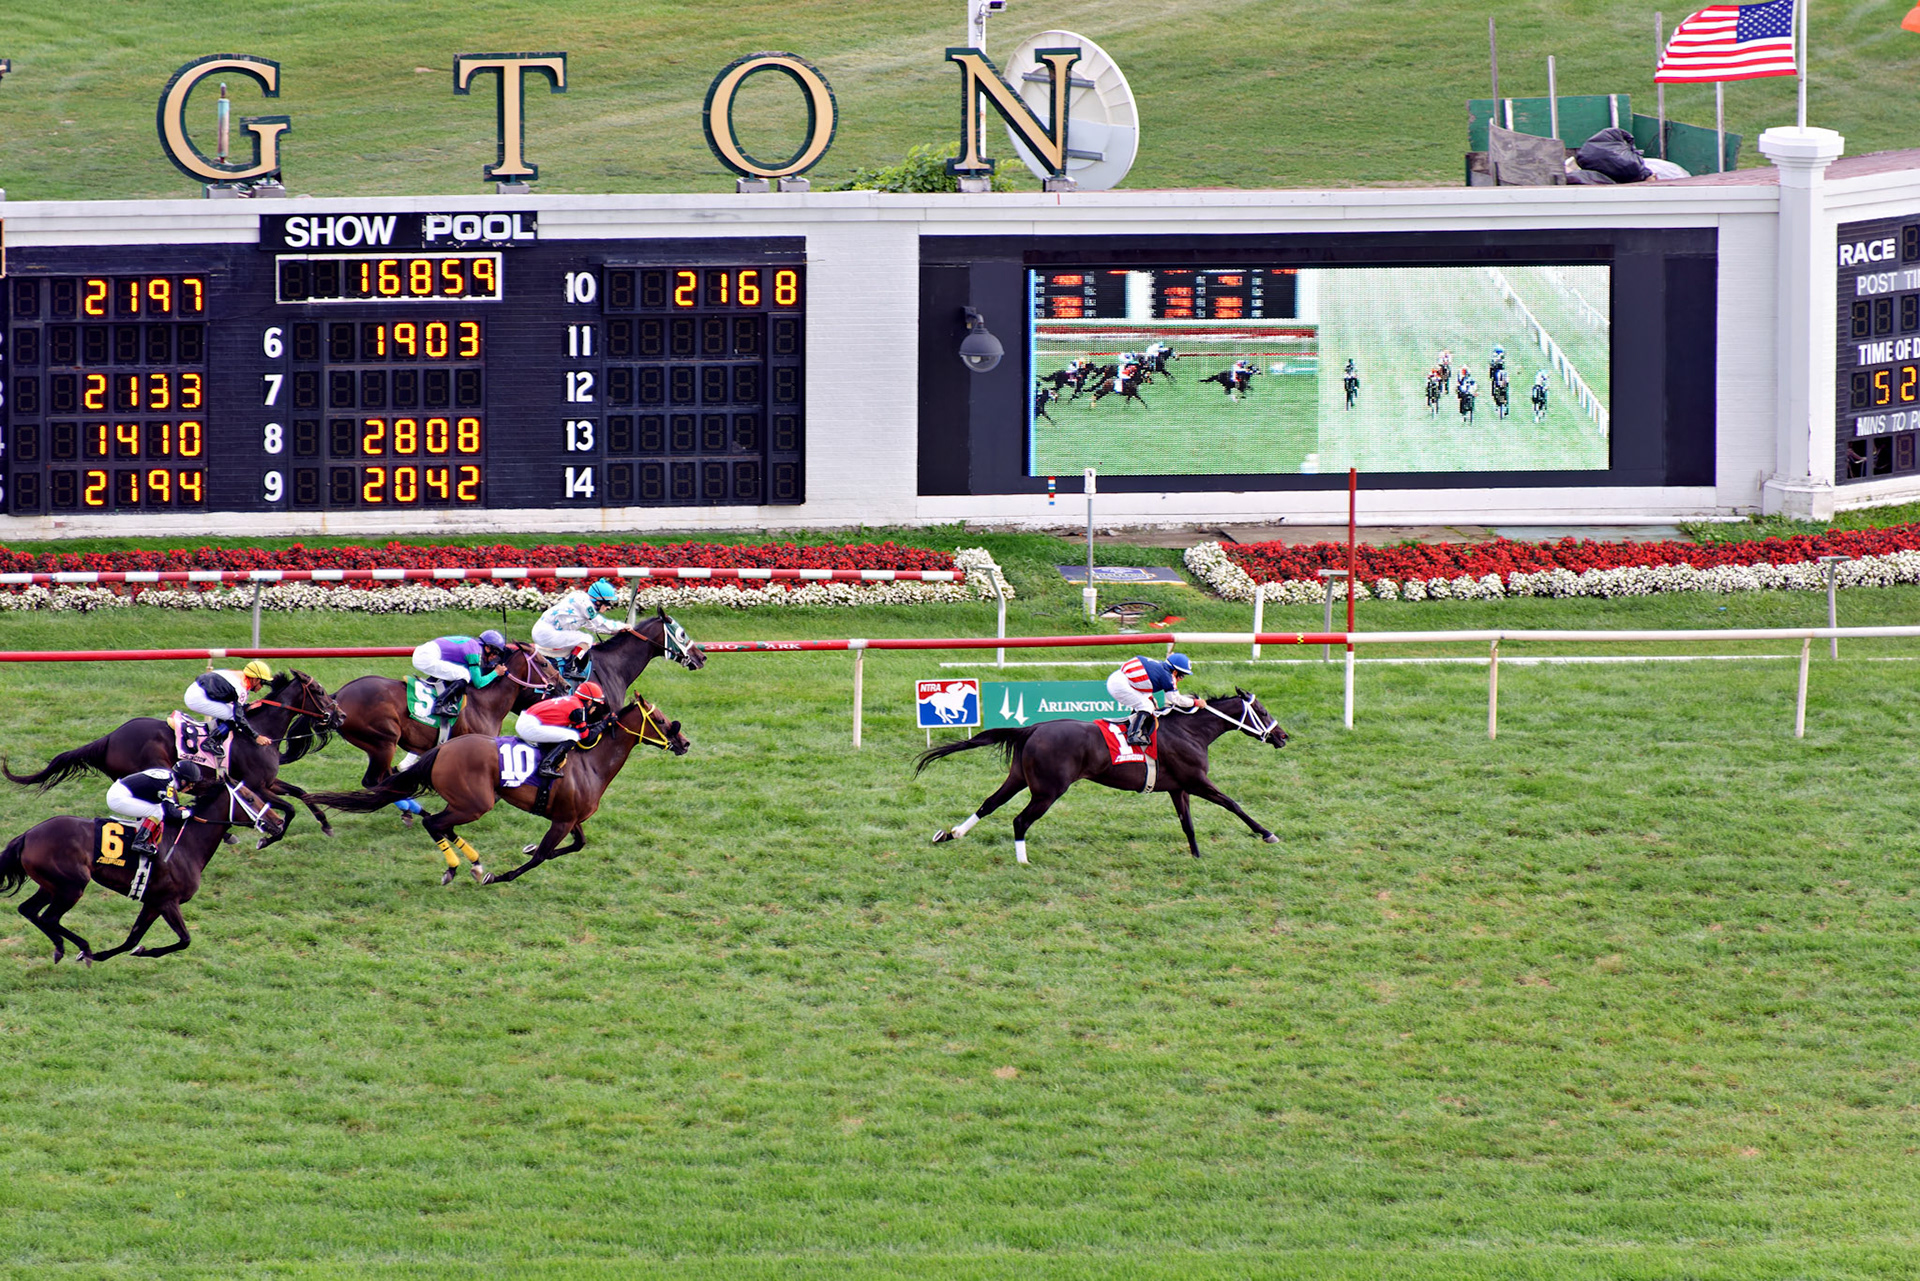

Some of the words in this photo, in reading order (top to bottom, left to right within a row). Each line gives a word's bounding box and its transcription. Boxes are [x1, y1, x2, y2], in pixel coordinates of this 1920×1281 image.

[284, 215, 397, 248] SHOW
[425, 214, 535, 241] POOL
[1839, 238, 1896, 267] RACE
[361, 258, 495, 295] 16859
[565, 271, 597, 303] 10
[674, 270, 798, 307] 2168
[1857, 272, 1898, 296] POST
[84, 278, 203, 315] 2197
[263, 326, 283, 359] 6
[376, 321, 480, 358] 1903
[568, 325, 592, 357] 11
[1858, 341, 1894, 366] TIME
[1895, 339, 1912, 361] OF
[84, 373, 202, 410] 2133
[264, 374, 283, 406] 7
[566, 371, 594, 403] 12
[98, 421, 202, 458] 1410
[264, 423, 283, 455] 8
[363, 417, 480, 455] 2808
[566, 420, 595, 452] 13
[1856, 415, 1887, 437] MINS
[1891, 411, 1907, 432] TO
[84, 469, 202, 506] 2194
[264, 470, 283, 502] 9
[363, 465, 480, 503] 2042
[565, 467, 595, 498] 14
[414, 681, 435, 717] 5
[920, 683, 942, 692] NTRA
[1037, 698, 1115, 713] ARLINGTON
[181, 722, 199, 754] 8
[1108, 723, 1134, 755] 1
[499, 743, 535, 783] 10
[101, 822, 125, 860] 6
